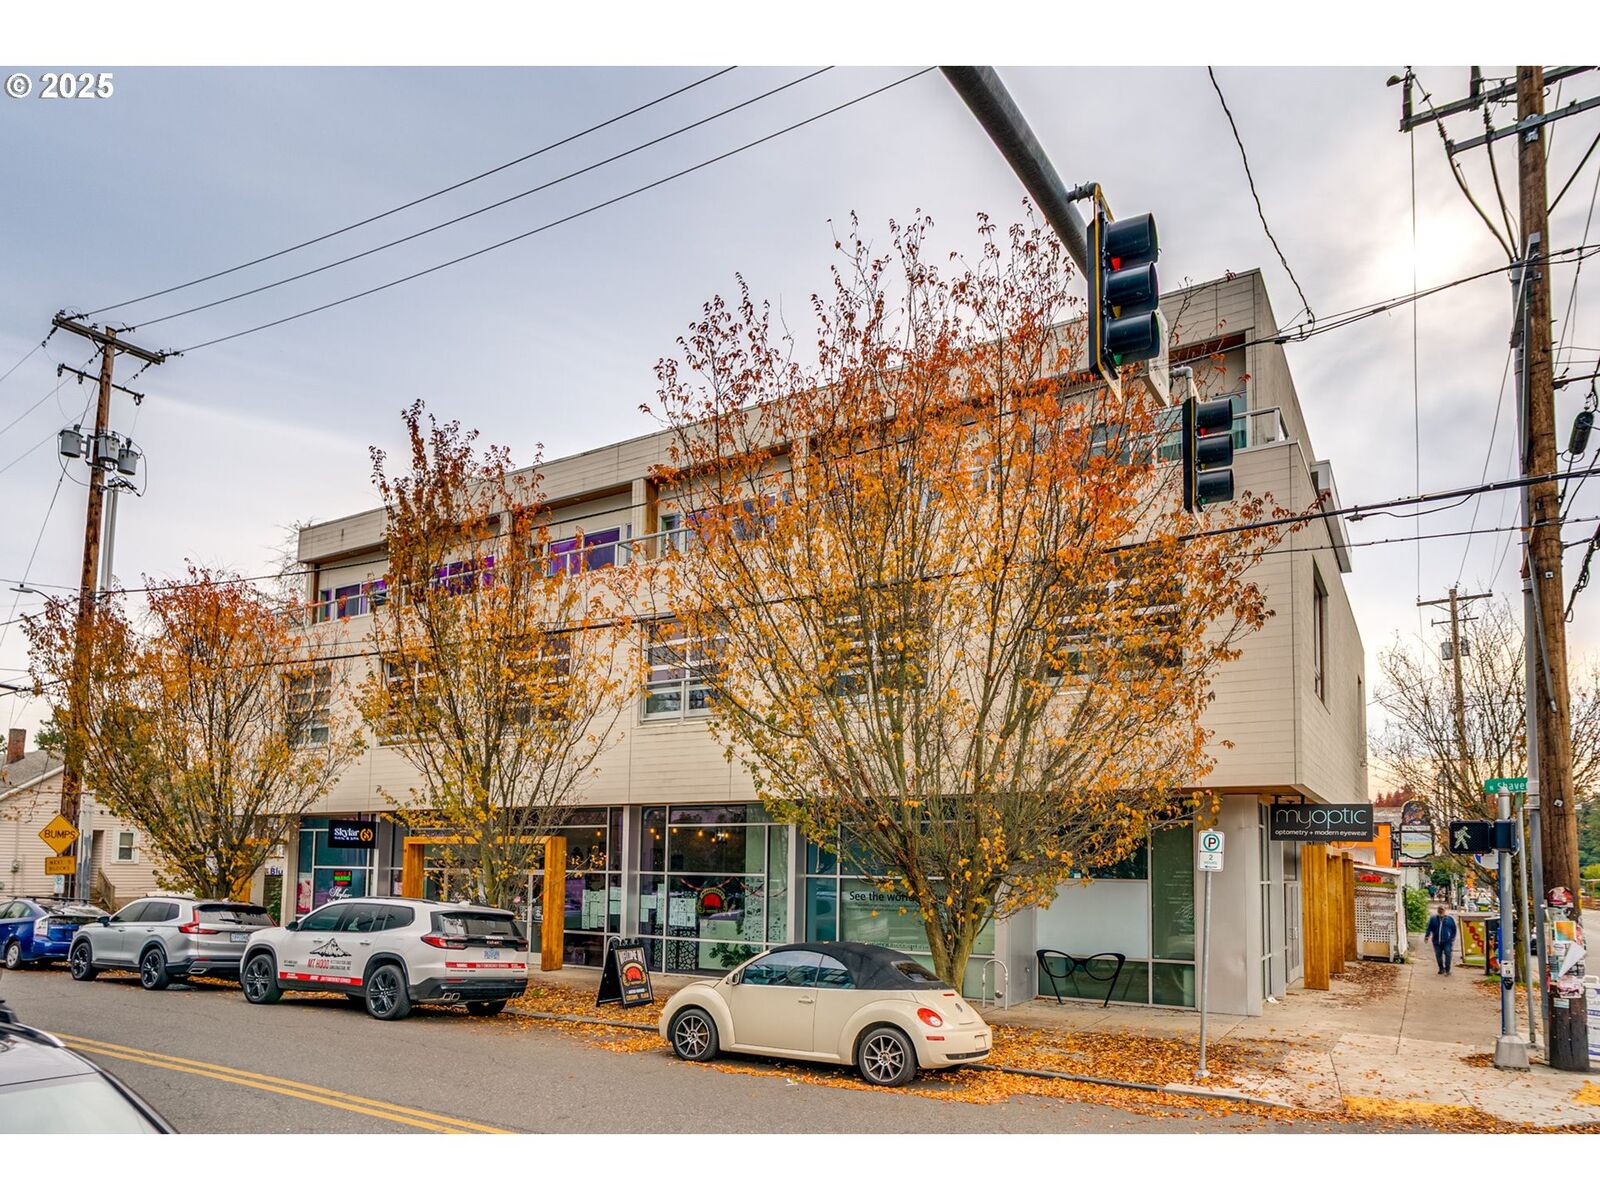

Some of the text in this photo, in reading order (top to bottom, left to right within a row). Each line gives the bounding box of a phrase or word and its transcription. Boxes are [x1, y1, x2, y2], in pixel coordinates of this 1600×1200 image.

[1497, 781, 1529, 791] Shave
[1276, 807, 1367, 830] myoptic
[44, 829, 76, 840] BUMPS
[334, 827, 360, 838] Skylar
[1275, 829, 1308, 837] optometry
[849, 890, 866, 901] See
[869, 891, 884, 901] the
